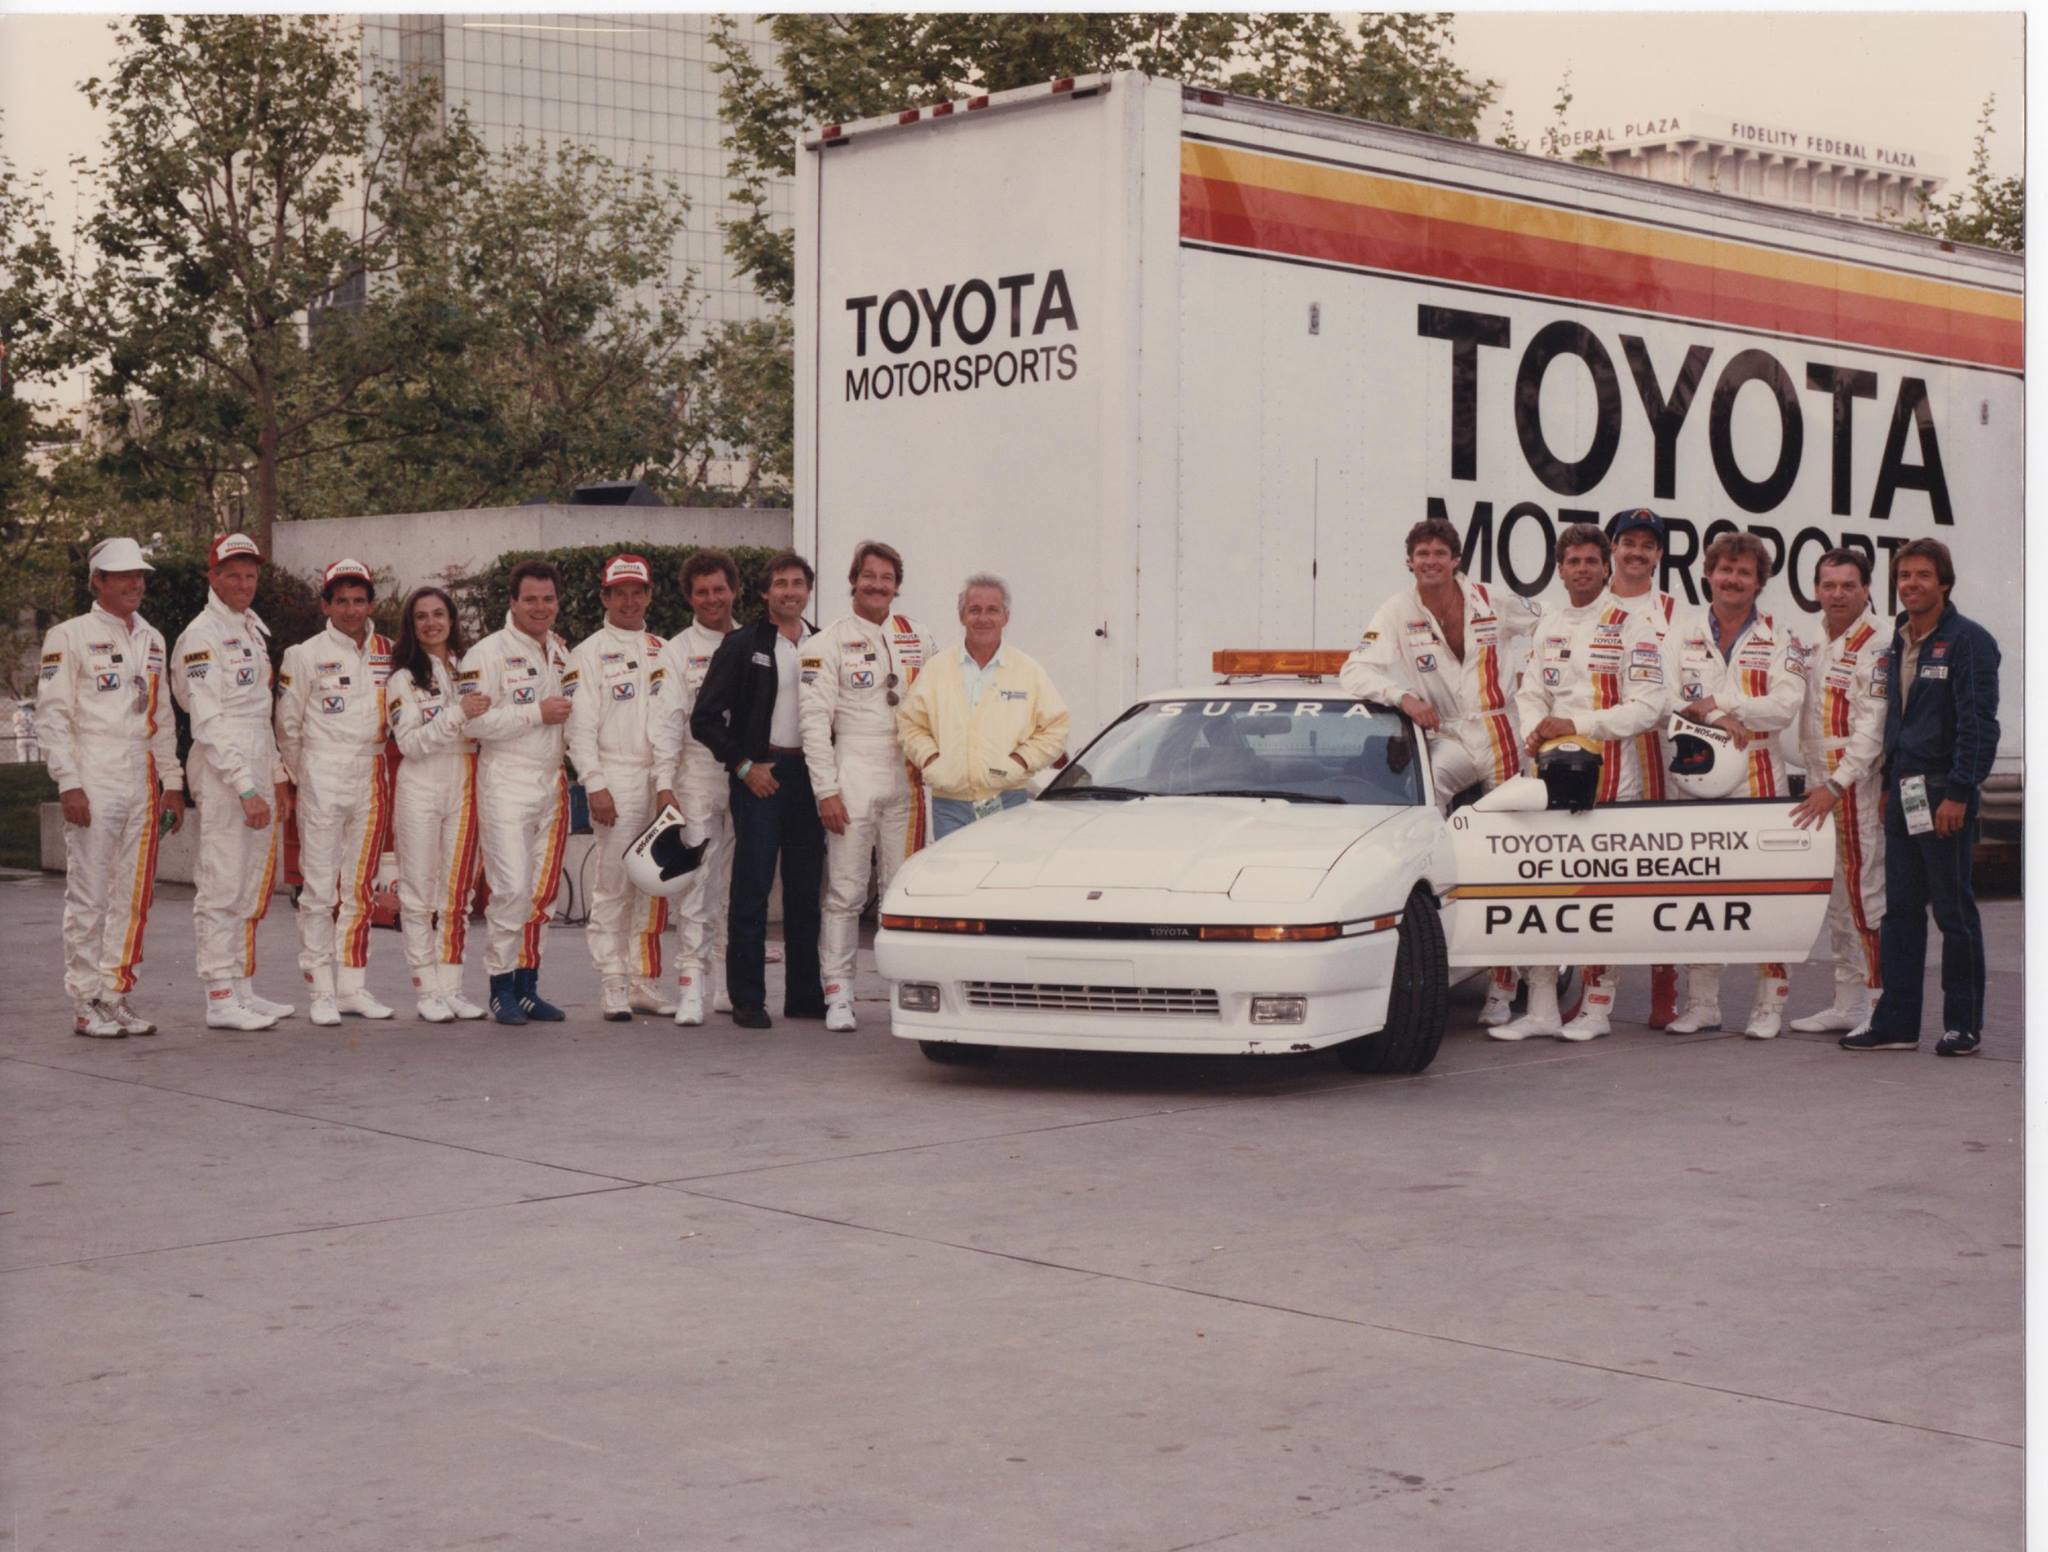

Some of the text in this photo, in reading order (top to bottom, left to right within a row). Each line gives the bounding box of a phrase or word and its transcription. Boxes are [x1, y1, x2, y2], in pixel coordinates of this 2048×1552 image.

[1625, 117, 1681, 137] PLAZA
[1731, 123, 1917, 168] FIDELITY FEDERAL PLAZA
[846, 269, 1079, 357] TOYOTA
[846, 343, 1078, 402] MOTORSPORTS
[1417, 303, 1955, 526] TOYOTA
[1593, 637, 1624, 645] TOYOTA
[1157, 702, 1373, 719] SUPRA
[1453, 815, 1469, 830] 01
[1485, 831, 1749, 854] TOYOTA GRAND PRIX
[1518, 856, 1720, 879] OF LONG BEACH
[1485, 902, 1752, 935] PACE CAR
[1150, 927, 1190, 937] TOYOTA
